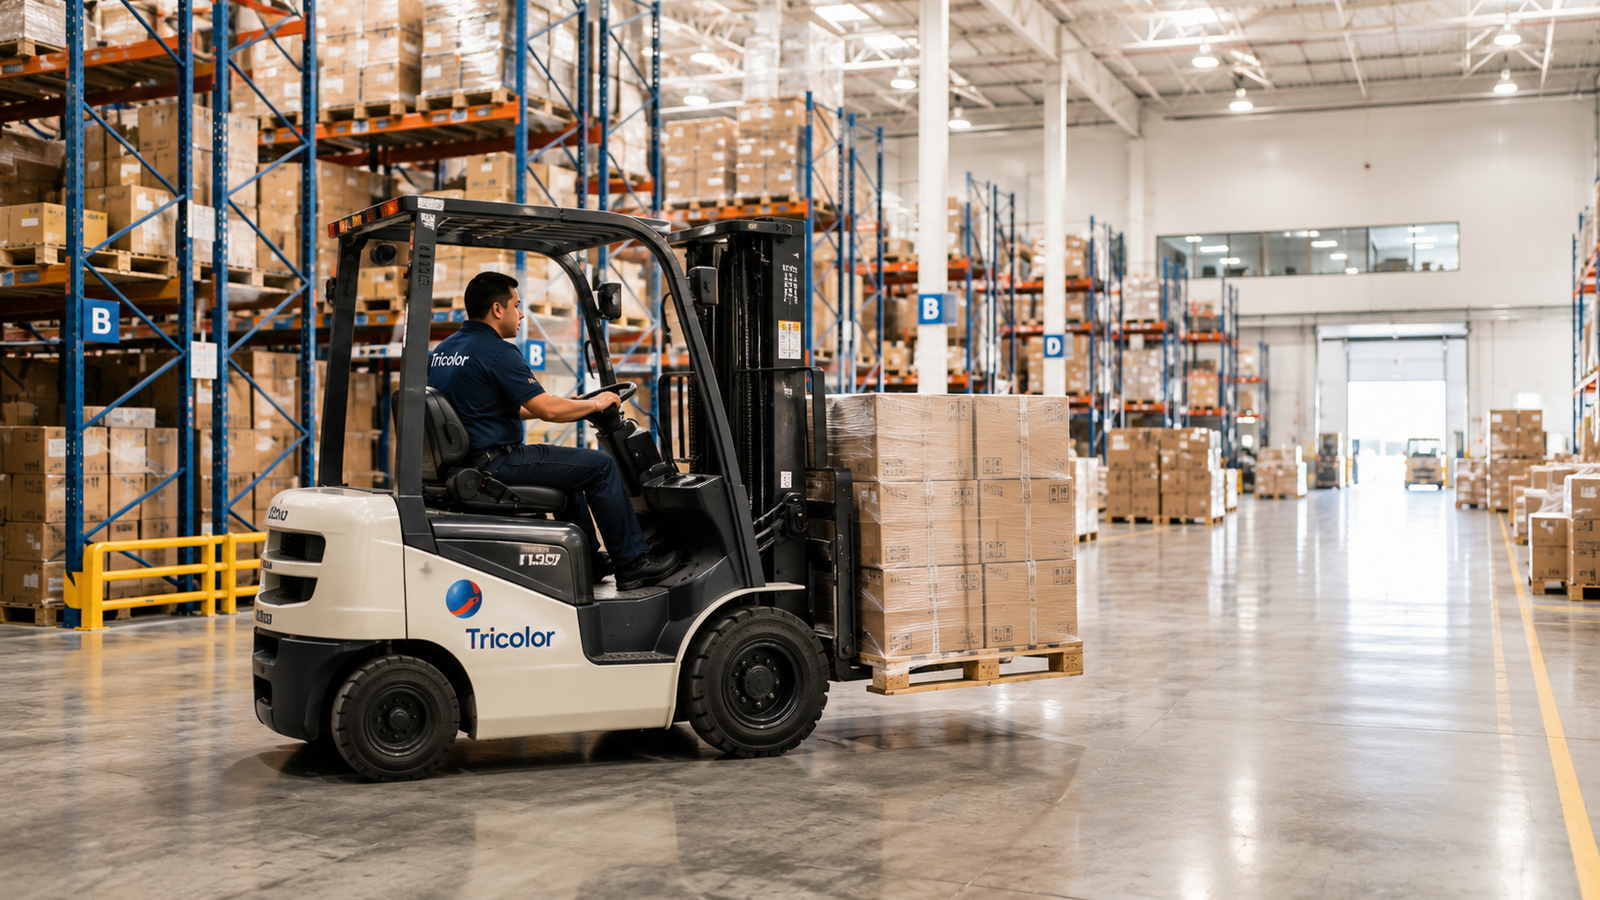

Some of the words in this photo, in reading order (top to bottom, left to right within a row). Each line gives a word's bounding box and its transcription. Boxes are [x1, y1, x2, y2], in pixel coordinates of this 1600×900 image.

[923, 298, 939, 320] B
[92, 307, 111, 335] B
[529, 344, 543, 366] B
[1047, 337, 1061, 355] D
[430, 351, 469, 367] Tricolor
[465, 626, 556, 650] Tricolor
